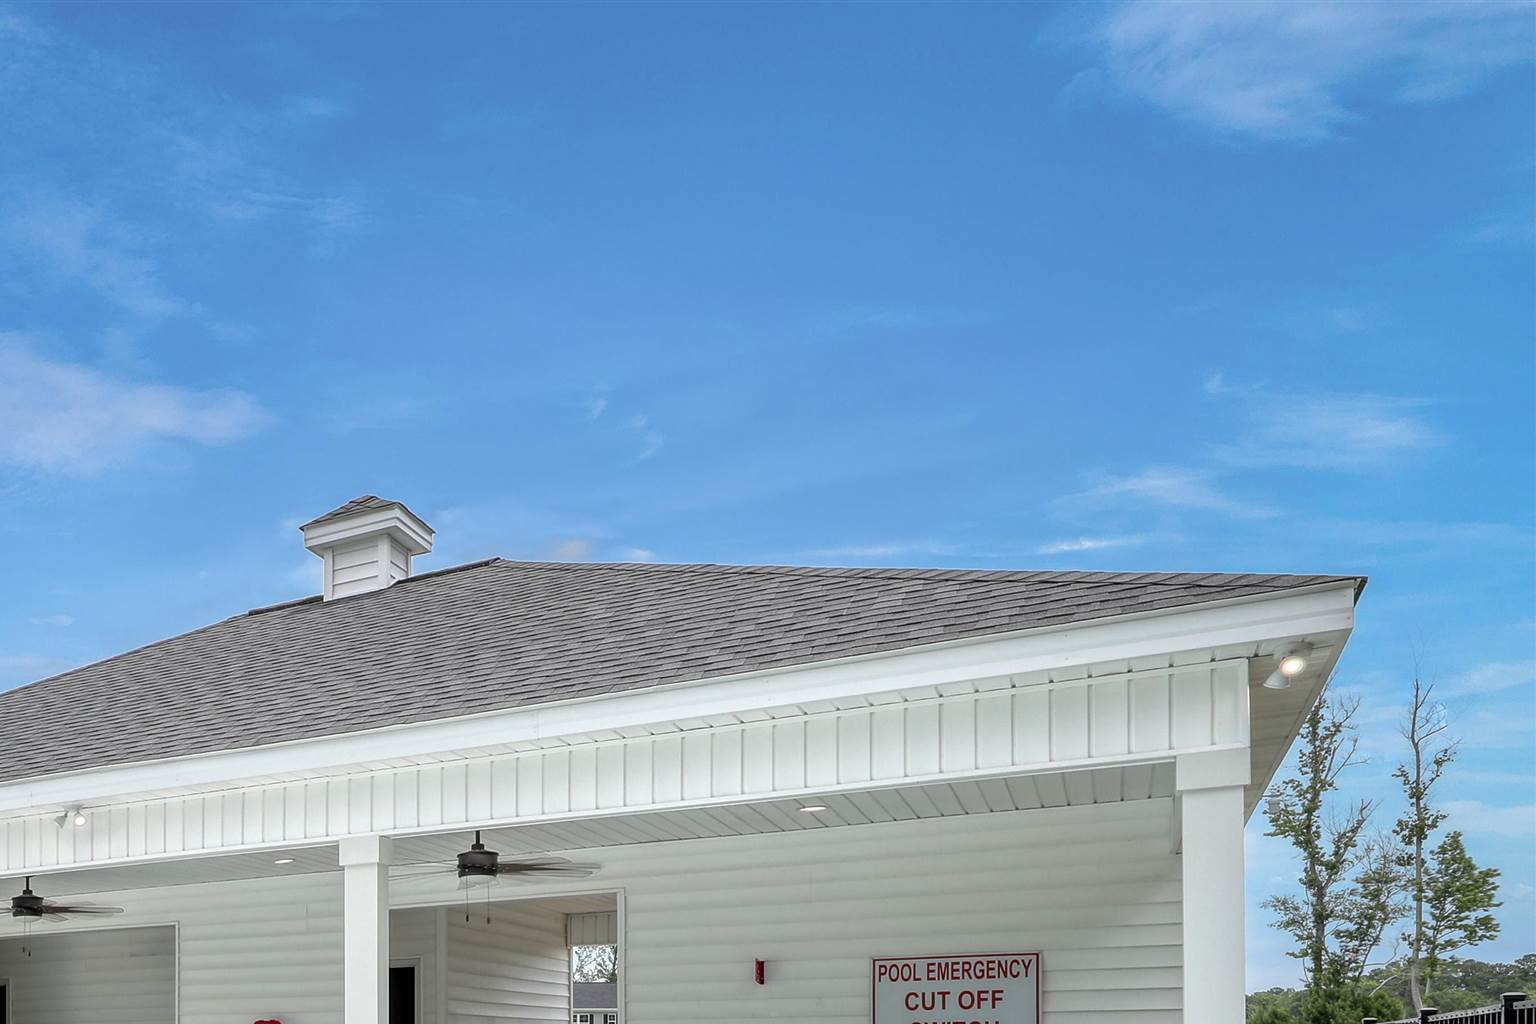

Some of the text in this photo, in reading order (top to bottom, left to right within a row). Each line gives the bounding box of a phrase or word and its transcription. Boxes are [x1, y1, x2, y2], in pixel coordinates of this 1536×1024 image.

[878, 959, 1033, 983] POOL EMERGENCY
[904, 989, 1004, 1011] CUT OFF
